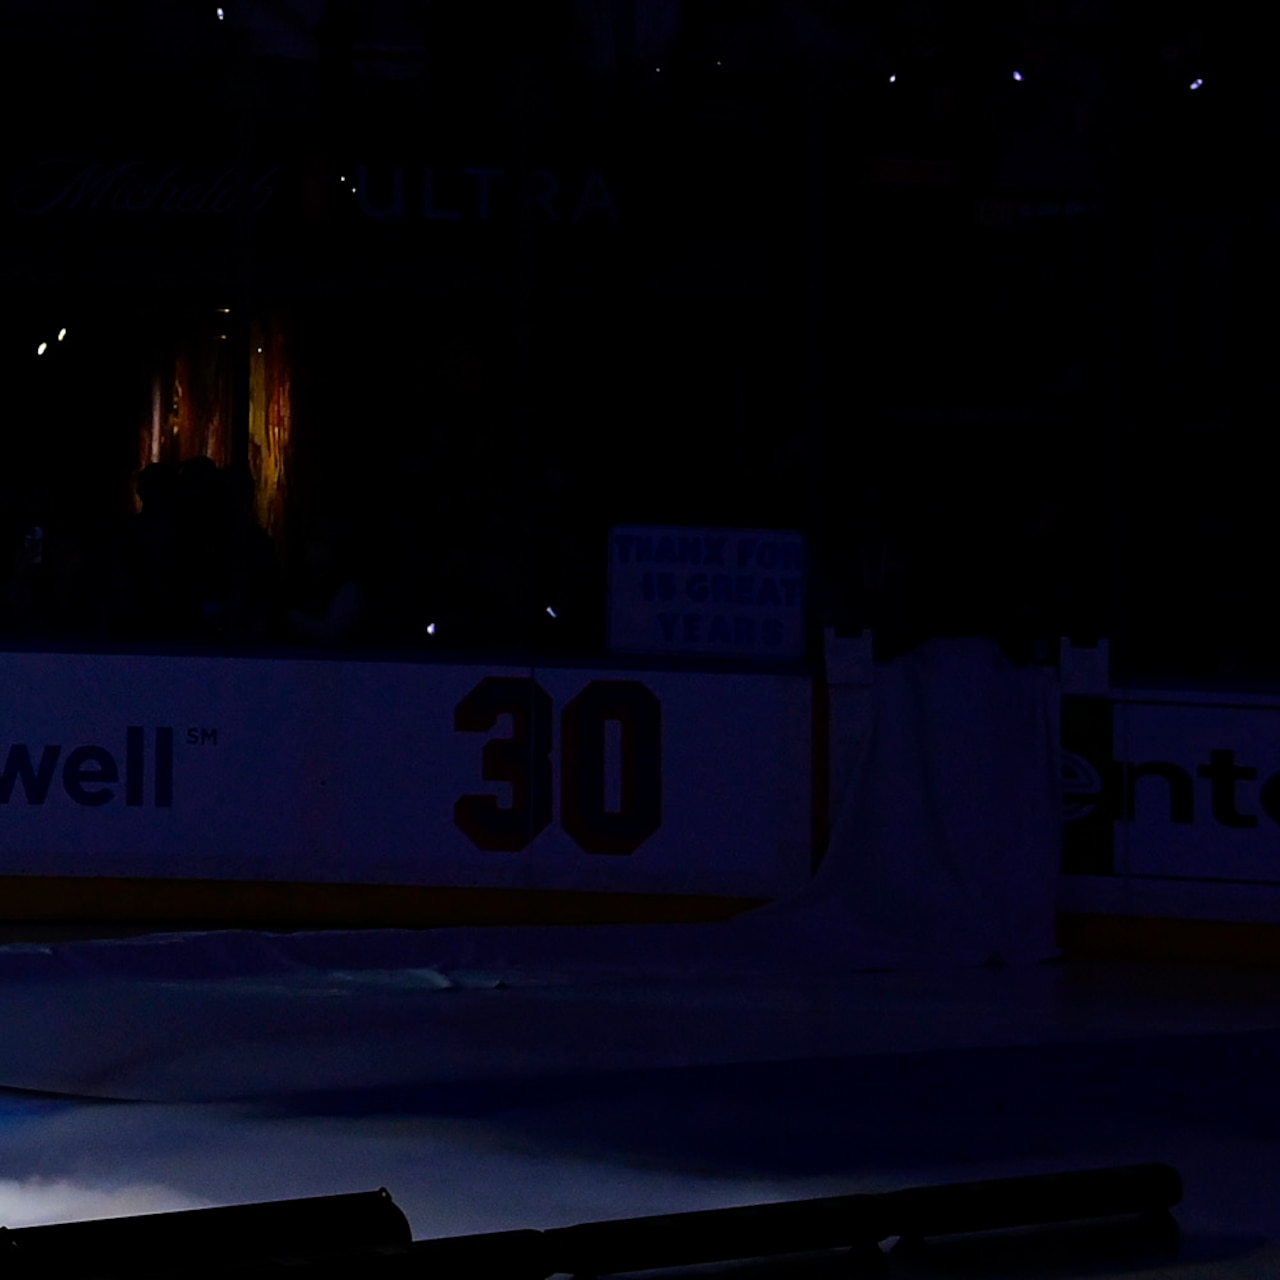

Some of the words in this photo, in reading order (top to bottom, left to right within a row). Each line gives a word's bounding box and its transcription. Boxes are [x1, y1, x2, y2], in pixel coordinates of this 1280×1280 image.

[11, 157, 282, 218] Michelob
[356, 165, 622, 226] ULTRA
[615, 534, 726, 566] THANX
[737, 537, 802, 570] FOR
[686, 573, 805, 606] GREAT
[657, 612, 784, 646] YEARS
[454, 676, 662, 855] 30
